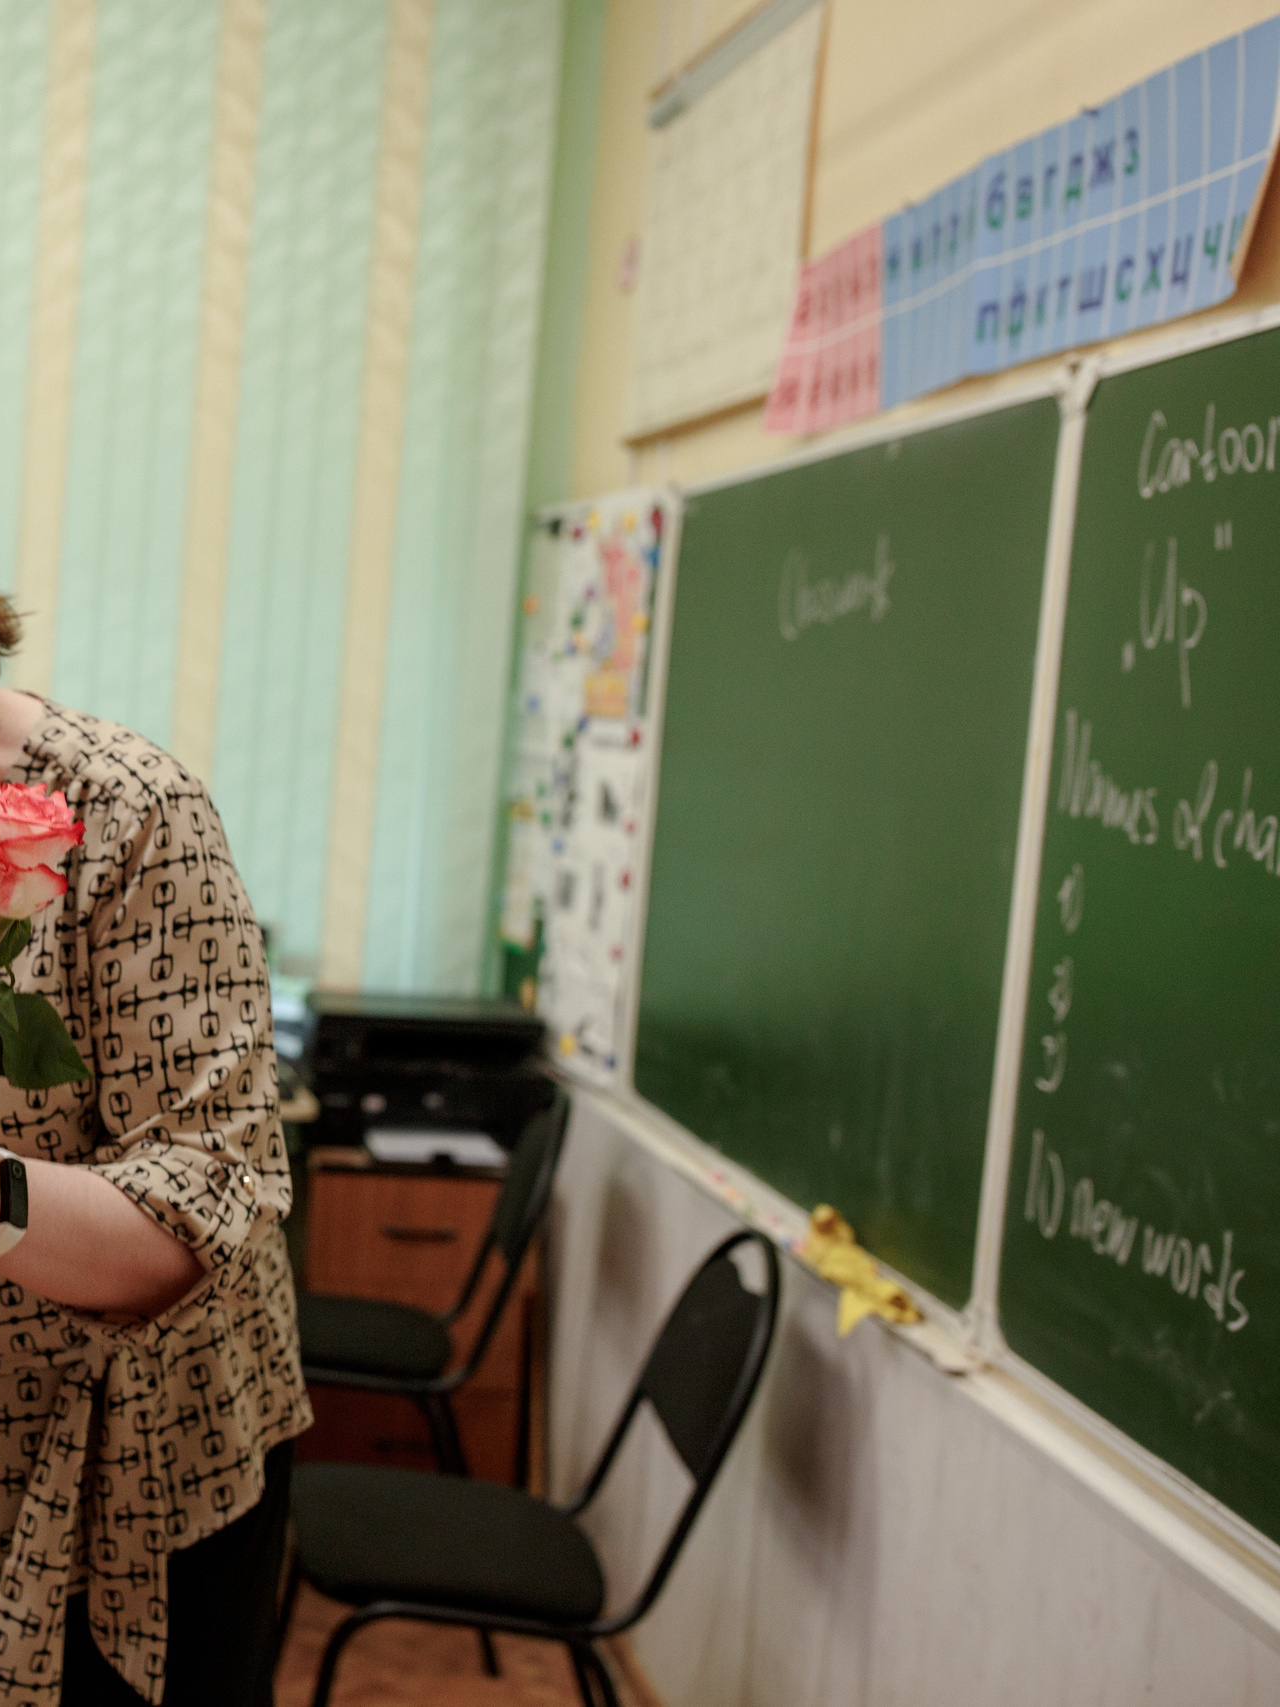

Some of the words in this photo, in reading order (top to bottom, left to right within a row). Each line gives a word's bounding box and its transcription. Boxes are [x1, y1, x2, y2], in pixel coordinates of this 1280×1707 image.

[1213, 767, 1280, 876] cha
[1024, 1128, 1065, 1240] 10
[1070, 1177, 1140, 1267] new
[1142, 1224, 1250, 1332] words
